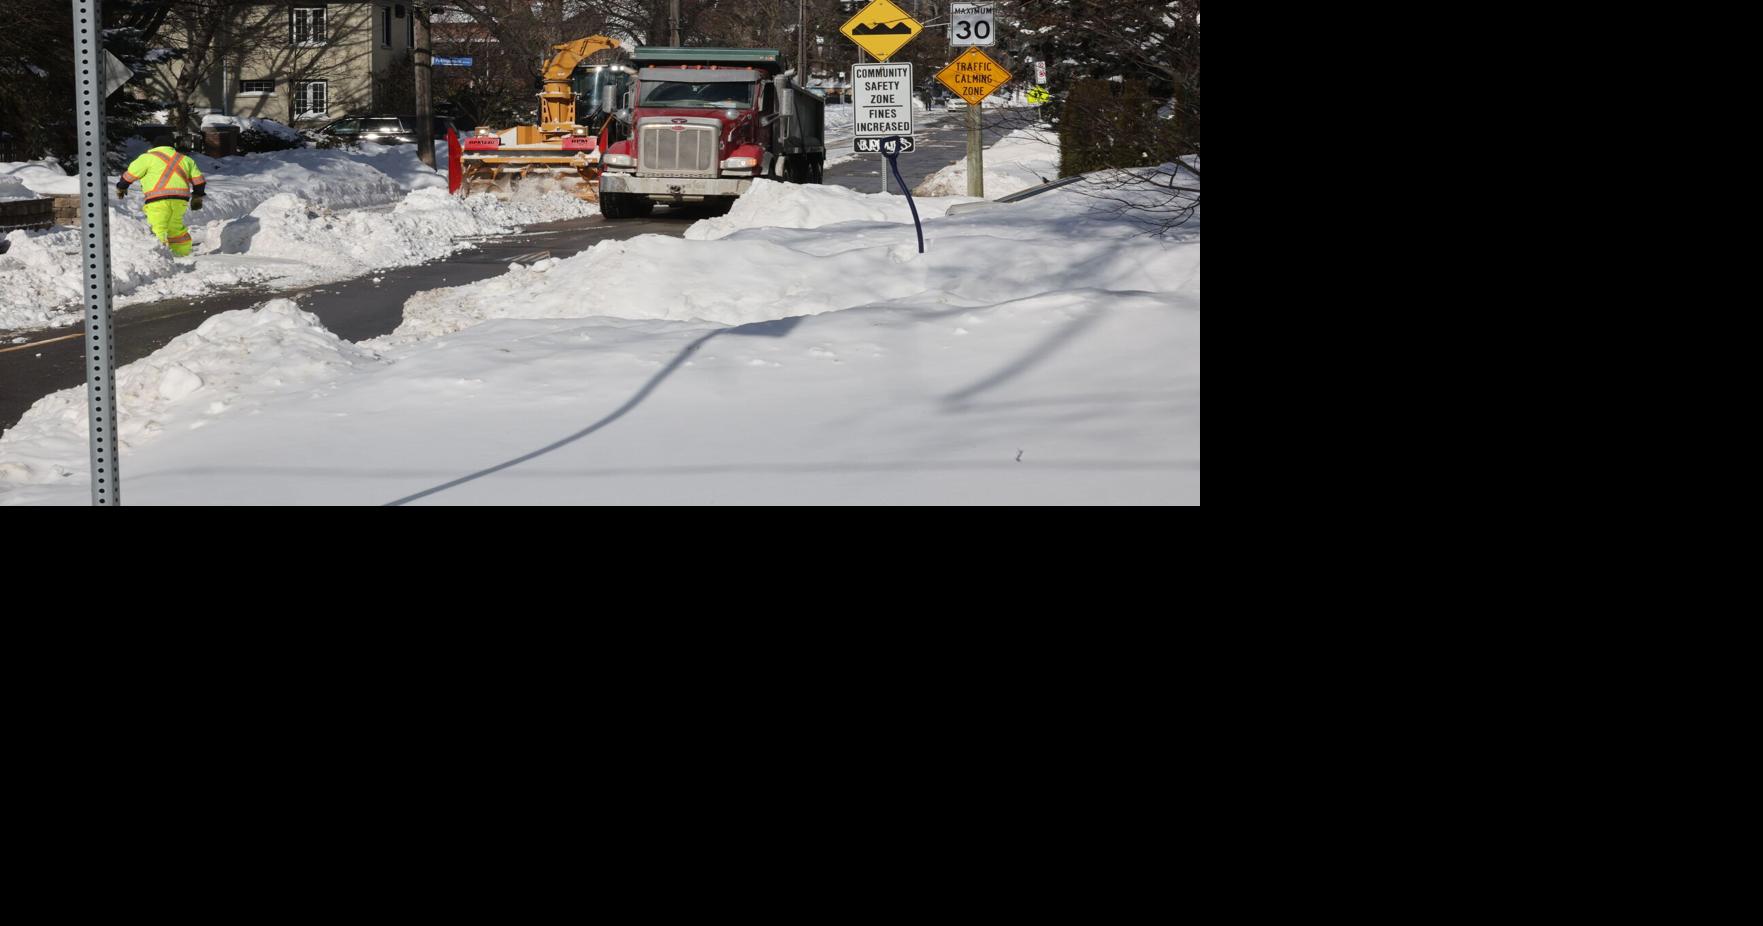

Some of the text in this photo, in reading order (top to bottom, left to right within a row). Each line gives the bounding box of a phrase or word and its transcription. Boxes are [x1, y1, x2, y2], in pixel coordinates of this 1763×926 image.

[956, 20, 990, 40] 30
[956, 62, 991, 71] TRAFFIC
[856, 68, 907, 78] COMMUNITY
[955, 74, 992, 83] CALMING
[865, 81, 899, 91] SAFETY
[963, 86, 984, 96] ZONE
[870, 94, 895, 104] ZONE
[869, 109, 897, 119] FINES
[857, 121, 910, 132] INCREASED
